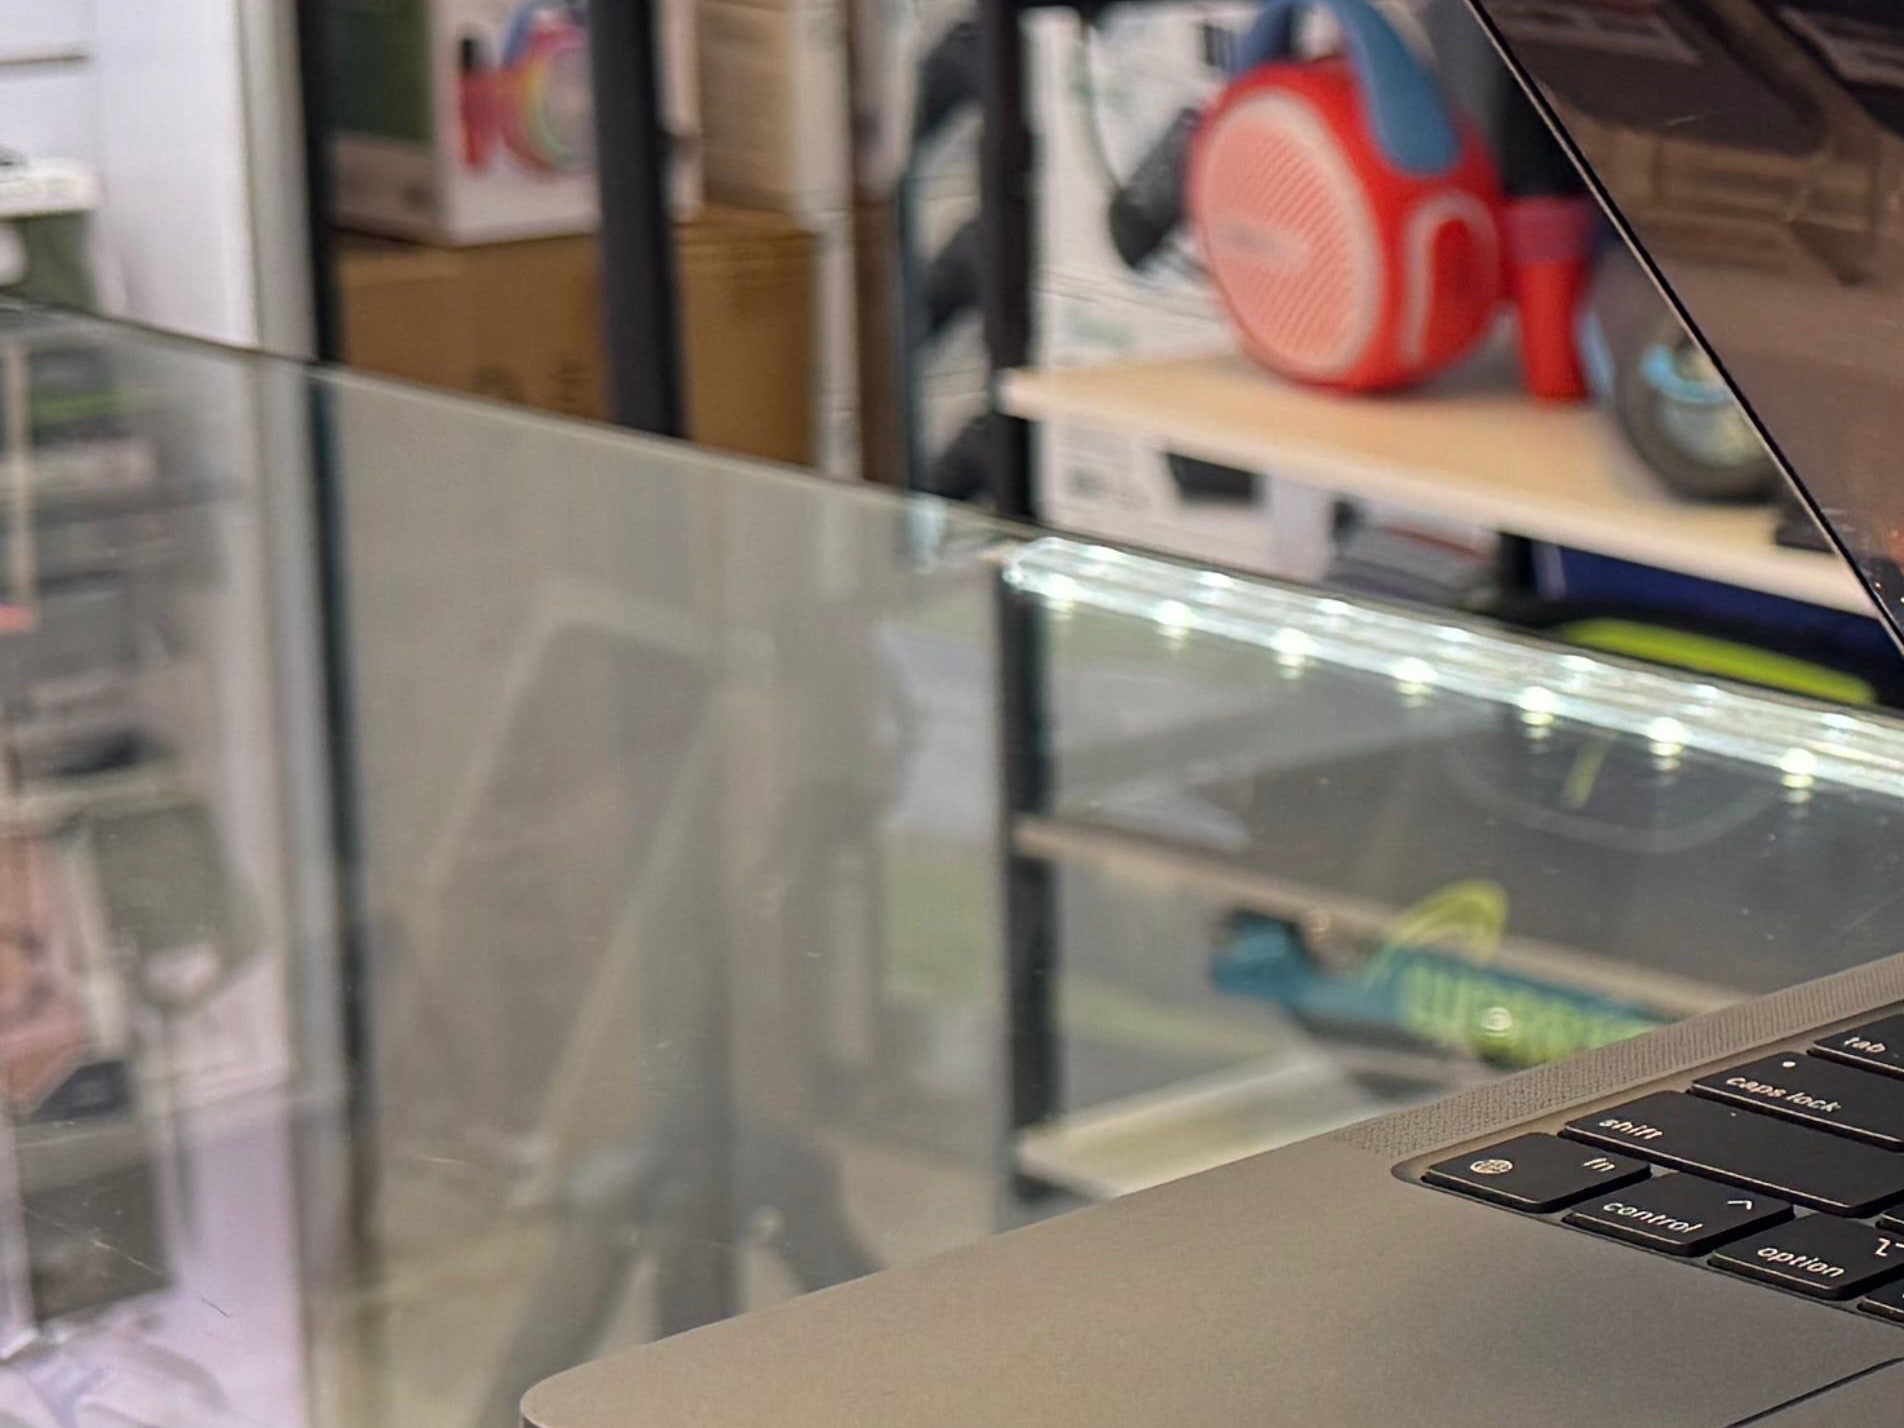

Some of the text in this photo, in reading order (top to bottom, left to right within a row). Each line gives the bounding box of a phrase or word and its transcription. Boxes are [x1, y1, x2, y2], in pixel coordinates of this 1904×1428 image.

[1726, 1074, 1841, 1113] caps lock
[1598, 1116, 1663, 1140] shift
[1602, 1198, 1703, 1233] control
[1757, 1243, 1844, 1279] option
